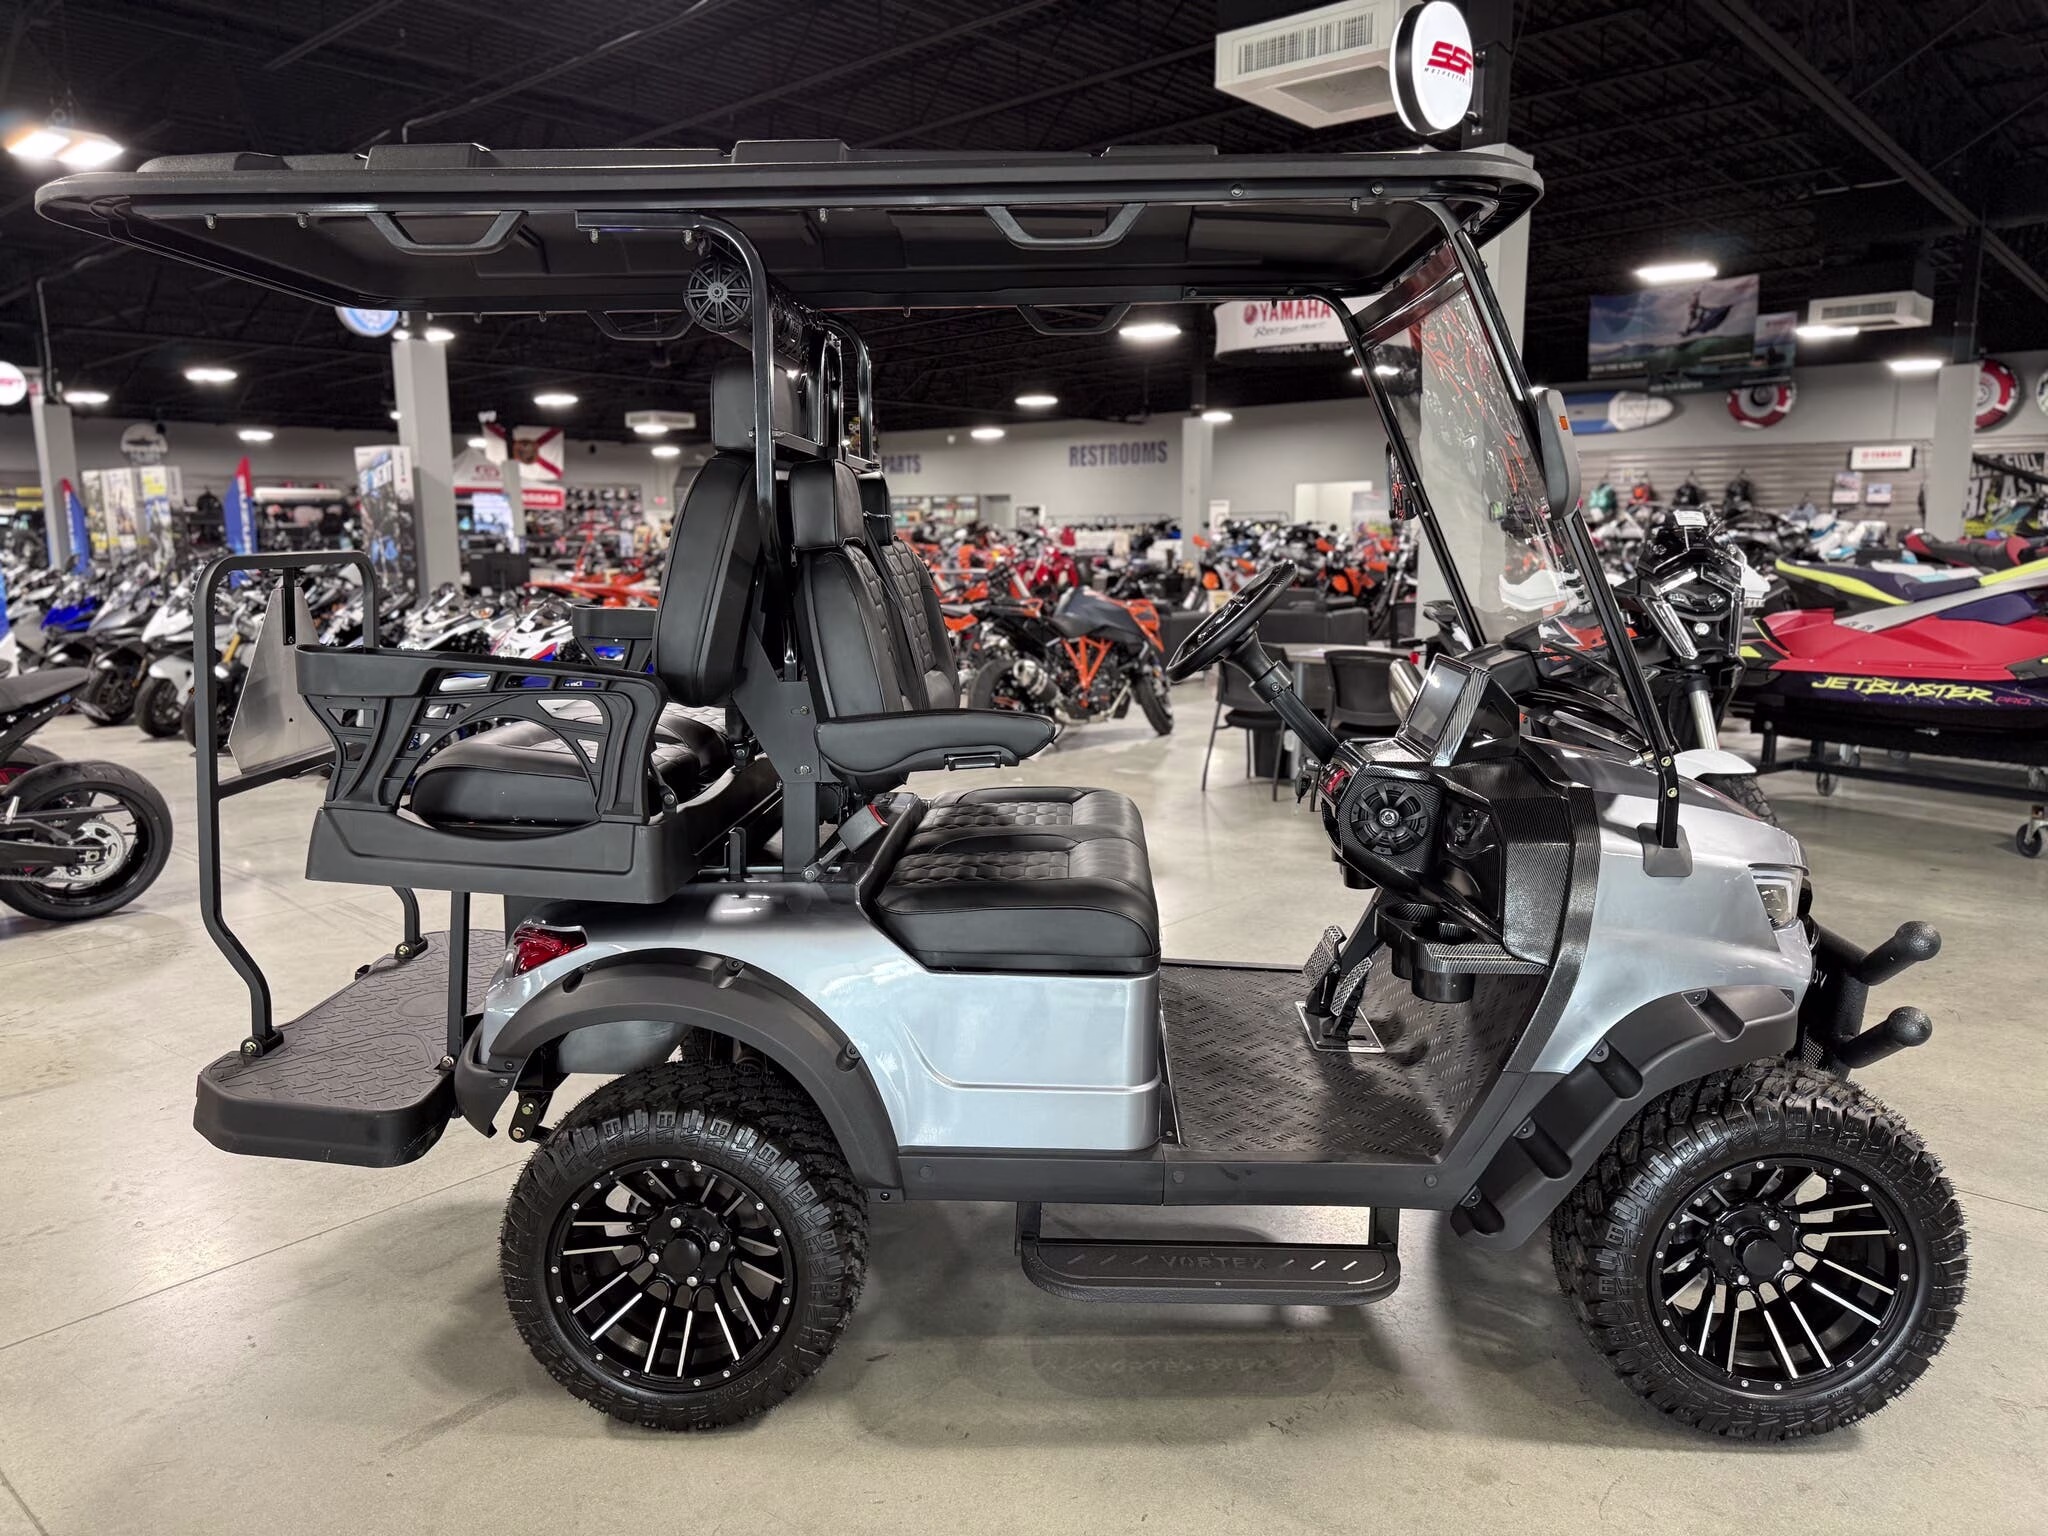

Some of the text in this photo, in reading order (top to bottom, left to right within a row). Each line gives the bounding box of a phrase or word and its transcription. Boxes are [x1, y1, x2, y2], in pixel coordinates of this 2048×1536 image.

[1260, 299, 1331, 321] YAMAHA
[881, 454, 921, 475] PARTS
[1069, 441, 1168, 467] RESTROOMS
[1811, 676, 1994, 703] JETBLASTER
[1160, 1255, 1265, 1270] VORTEX
